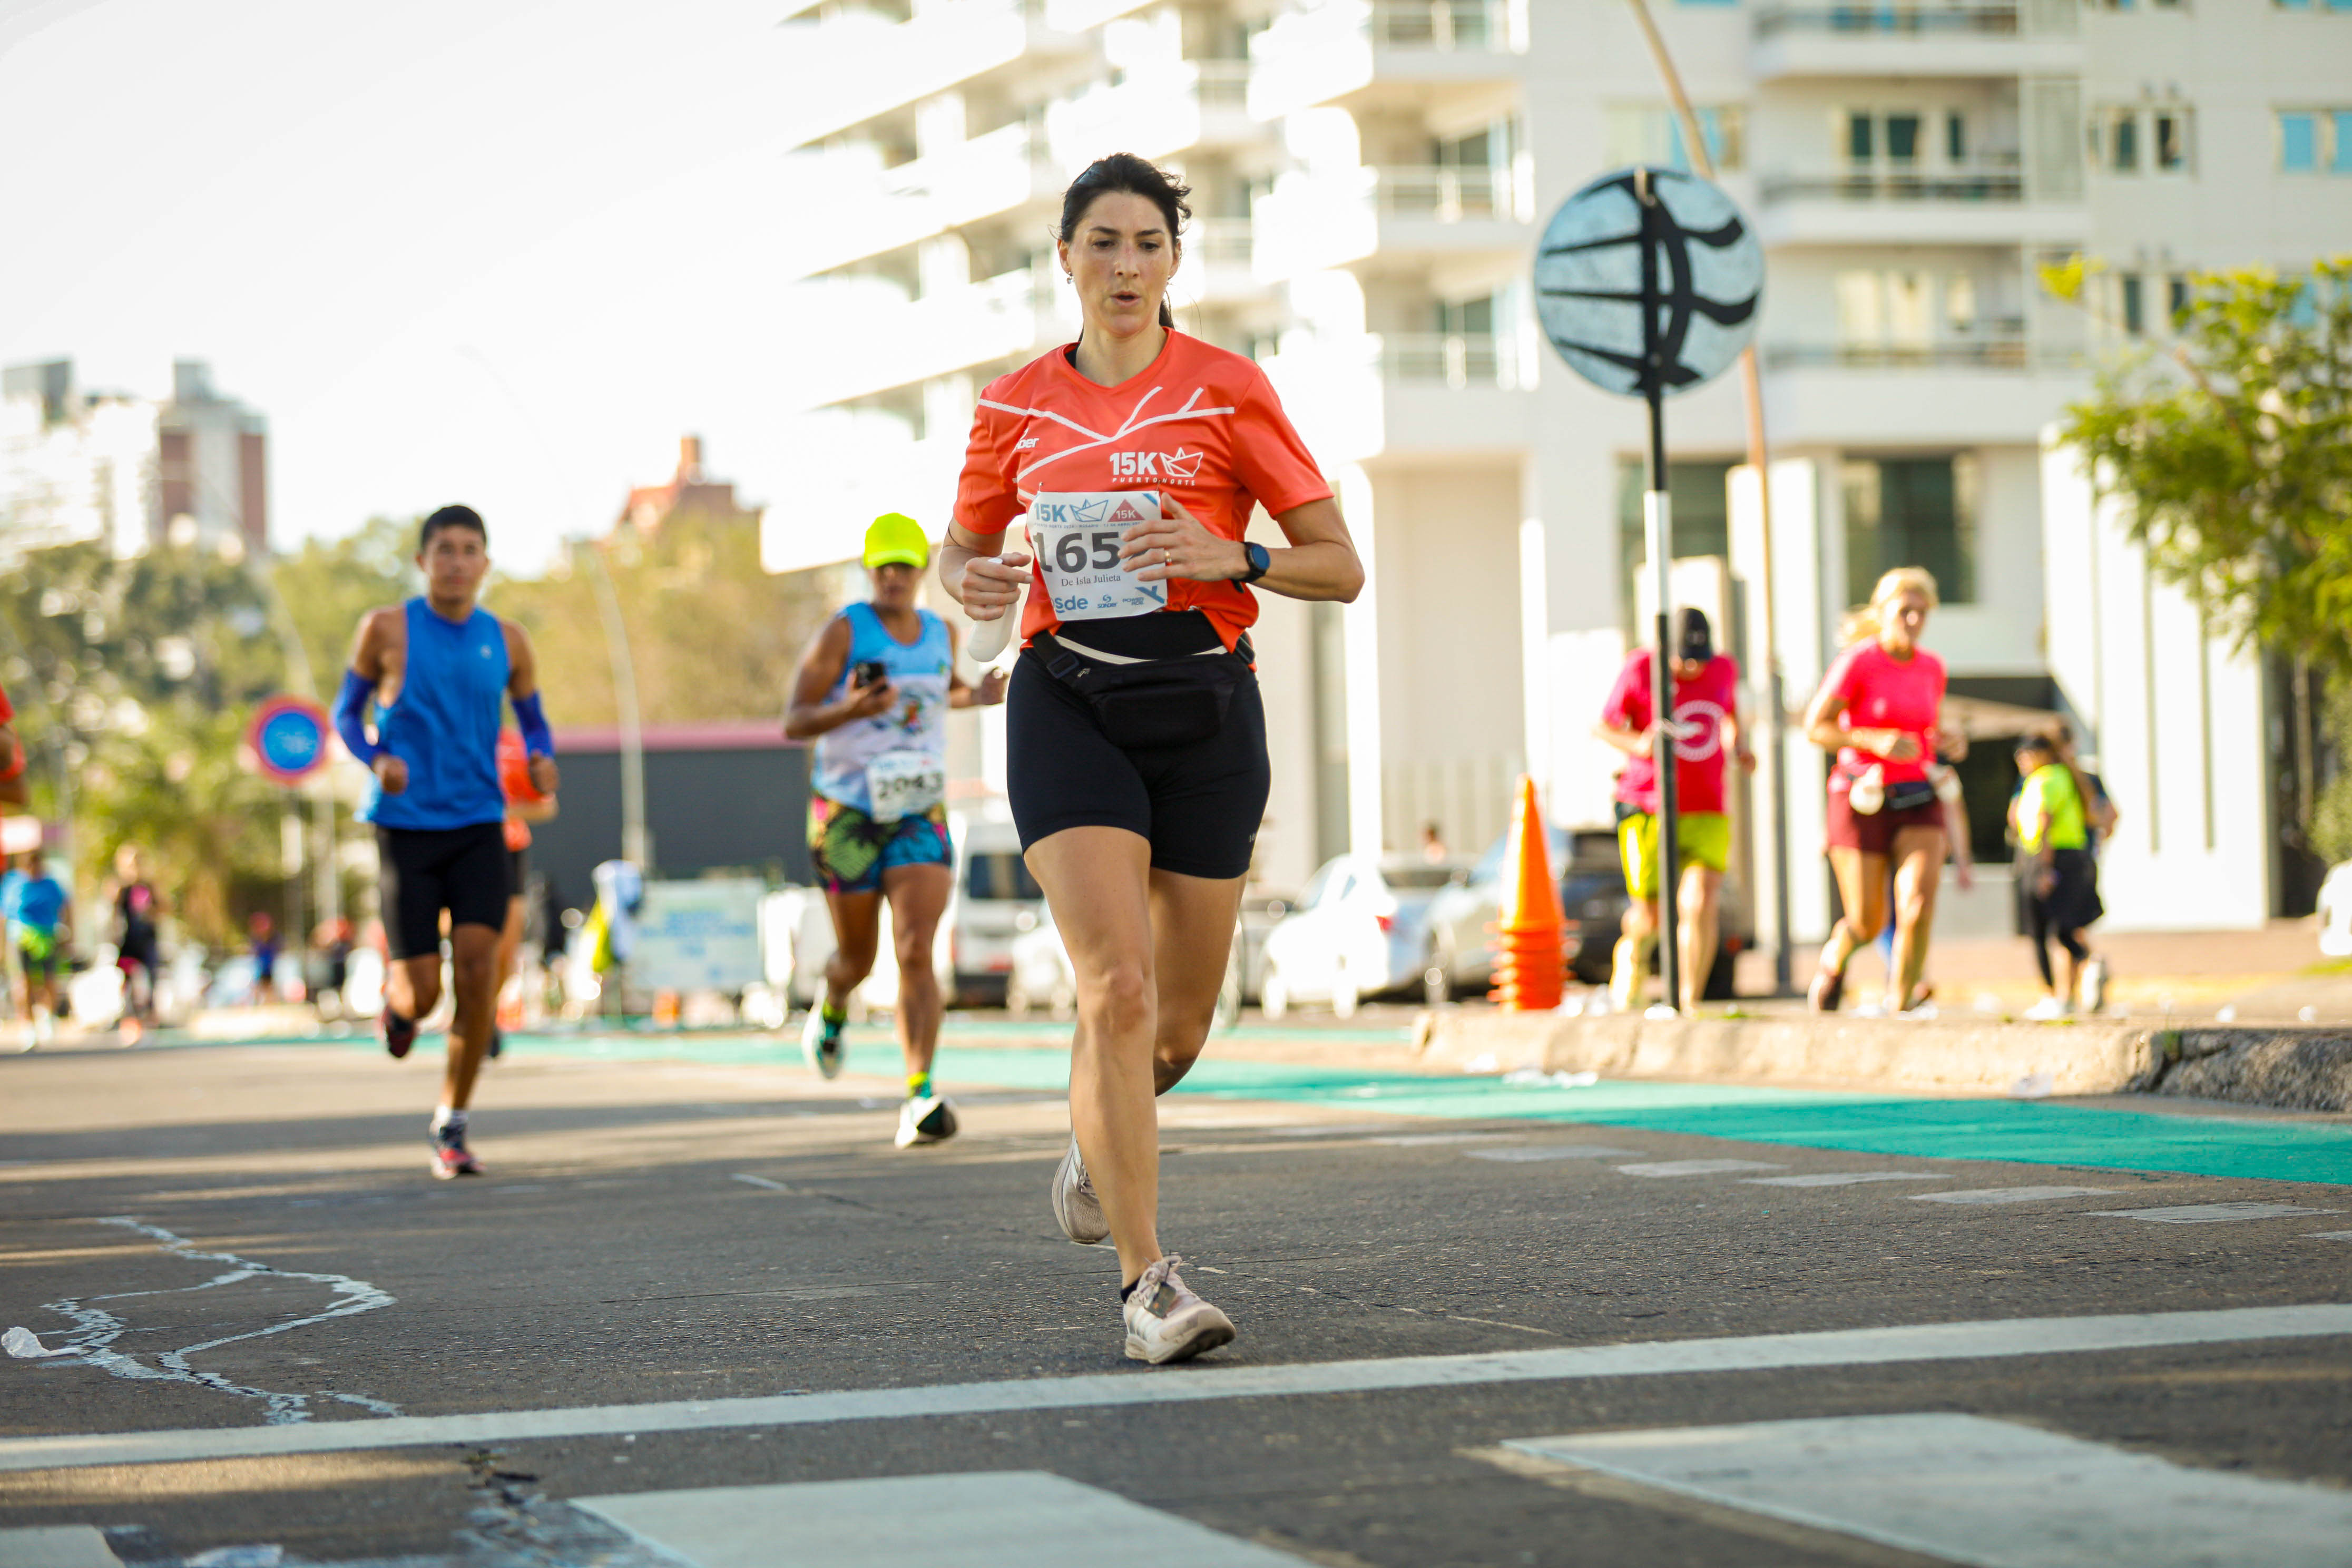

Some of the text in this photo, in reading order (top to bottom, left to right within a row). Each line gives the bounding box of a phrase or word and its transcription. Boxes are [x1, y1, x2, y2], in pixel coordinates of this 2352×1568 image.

[1109, 452, 1158, 475] 15K
[1034, 503, 1067, 522] 15K
[1115, 509, 1136, 519] 15K
[1033, 532, 1151, 573] 165
[1061, 574, 1121, 586] De Isla Julieta
[1052, 595, 1088, 610] sde
